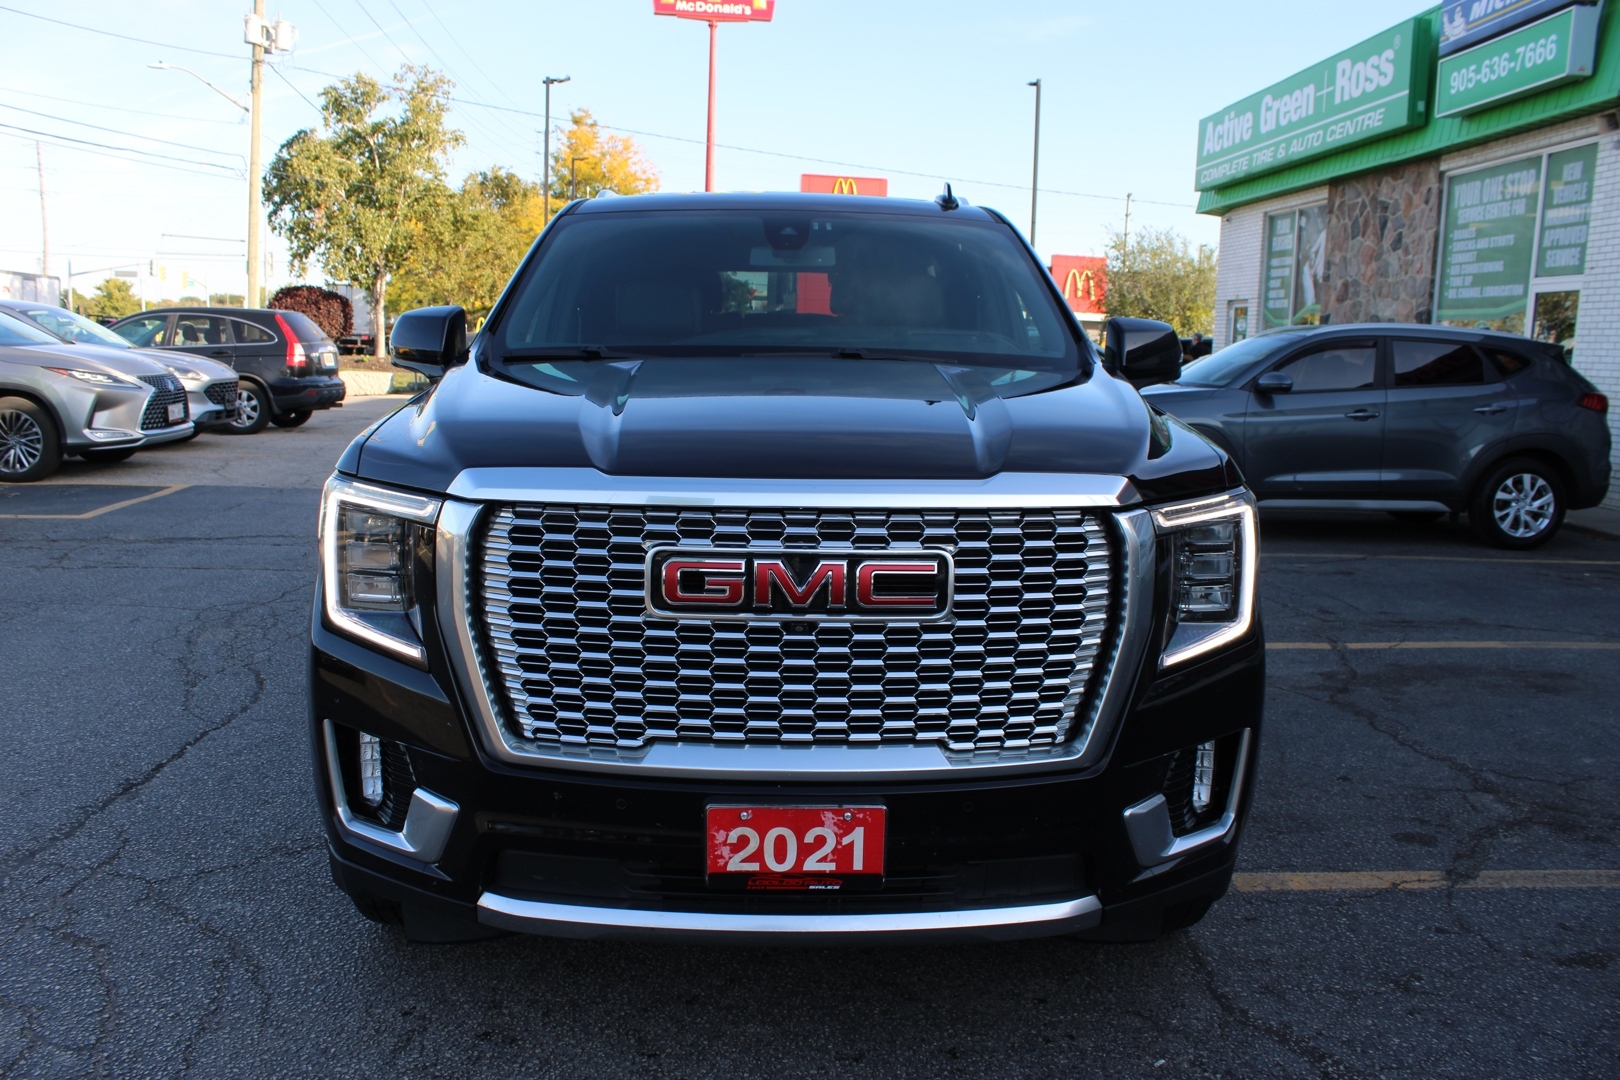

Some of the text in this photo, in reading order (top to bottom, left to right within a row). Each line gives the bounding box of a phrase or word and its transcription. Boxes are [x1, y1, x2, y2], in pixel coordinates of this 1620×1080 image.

[675, 0, 752, 15] McDonald's
[1450, 34, 1559, 95] 905-636-7666
[1203, 111, 1253, 157] Active
[1260, 83, 1315, 134] Green
[1334, 48, 1395, 105] Ross
[1201, 107, 1386, 184] COMPLETE TIRE & AUTO CENTRE
[1562, 161, 1584, 182] NEW
[1454, 168, 1537, 209] YOUR ONE STOP
[1553, 181, 1589, 206] VEHICLE
[1457, 205, 1485, 225] SERVICE
[1485, 201, 1511, 220] CENTRE
[1542, 225, 1588, 247] APPROVED
[1545, 247, 1582, 268] SERVICE
[661, 556, 939, 610] GMC
[726, 826, 865, 873] 2021
